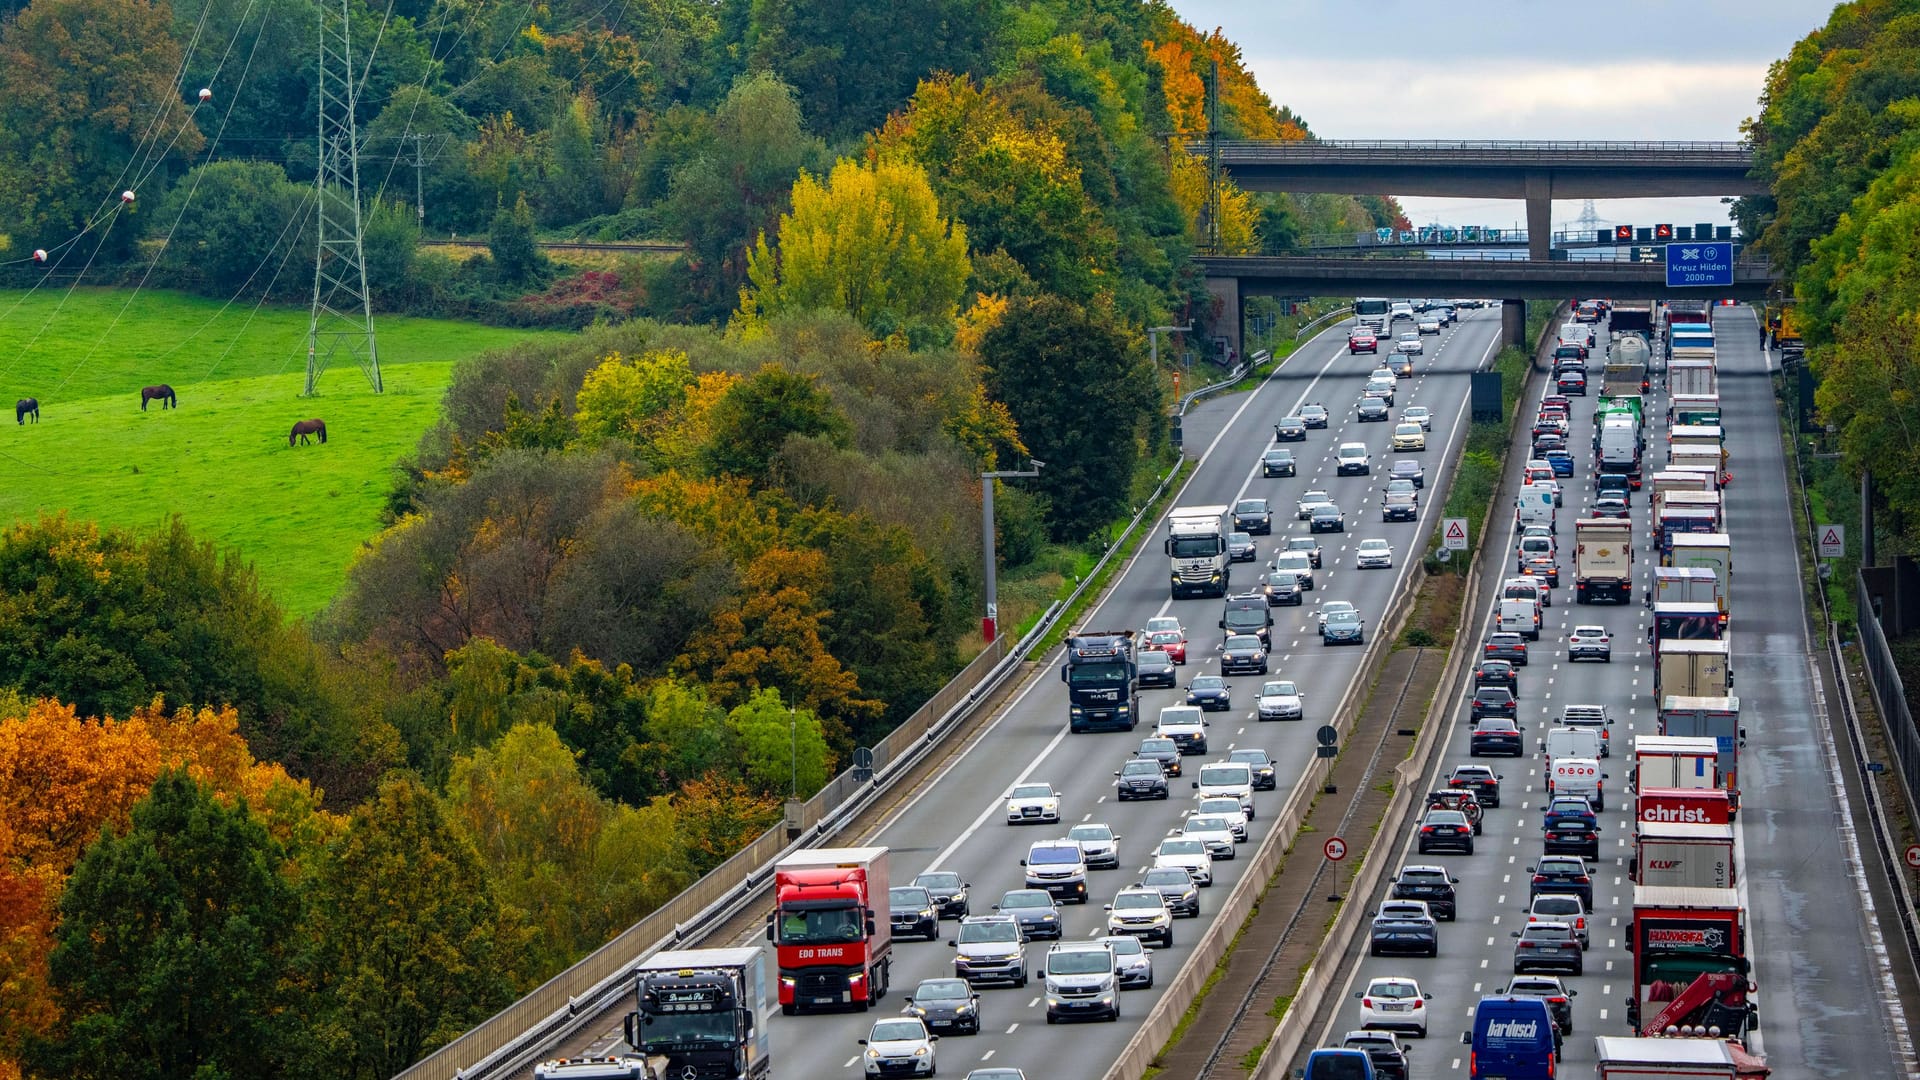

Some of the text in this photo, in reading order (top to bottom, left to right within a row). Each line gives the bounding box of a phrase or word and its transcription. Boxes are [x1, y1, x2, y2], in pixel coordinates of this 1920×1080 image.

[1672, 263, 1727, 272] Kreuz Hilden
[1685, 273, 1705, 281] 2000
[1644, 804, 1711, 823] christ.
[1649, 860, 1673, 869] KLV
[1648, 929, 1704, 943] HAMOFA
[817, 948, 843, 957] TRANS
[1486, 1018, 1537, 1038] bardusch
